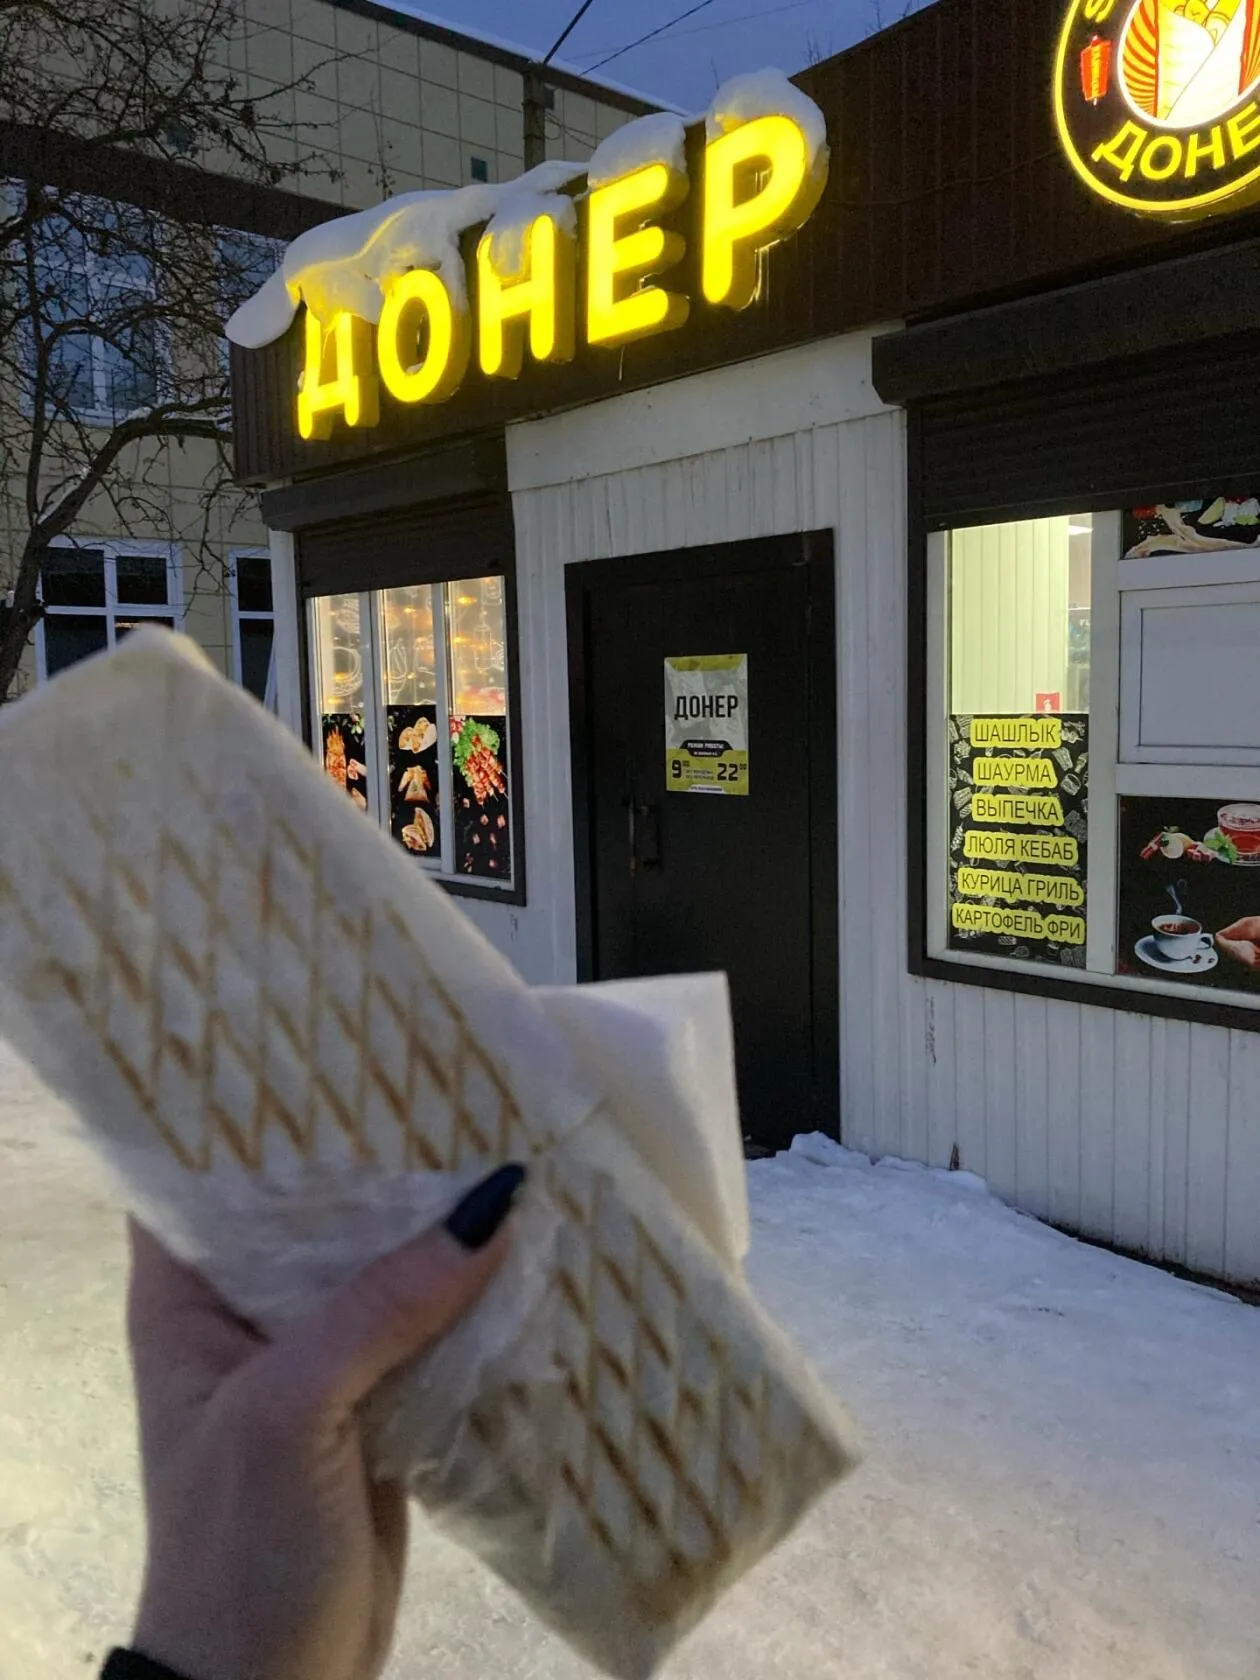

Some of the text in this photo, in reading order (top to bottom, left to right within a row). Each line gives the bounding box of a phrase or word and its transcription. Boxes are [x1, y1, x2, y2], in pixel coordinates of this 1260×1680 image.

[297, 113, 812, 441] ДОНЕР
[674, 695, 738, 720] ДОНЕР
[975, 723, 1056, 744] ШАШЛЫК
[672, 760, 682, 778] 9
[717, 763, 738, 781] 22
[977, 762, 1052, 784] ШАУРМА
[976, 798, 1059, 821] ВЫПЕЧКА
[967, 834, 1074, 861] ЛЮЛЯ КЕБАБ
[962, 872, 1080, 901] КУРИЦА ГРИЛЬ
[955, 907, 1081, 939] КАРТОФЕЛЬ ФРИ
